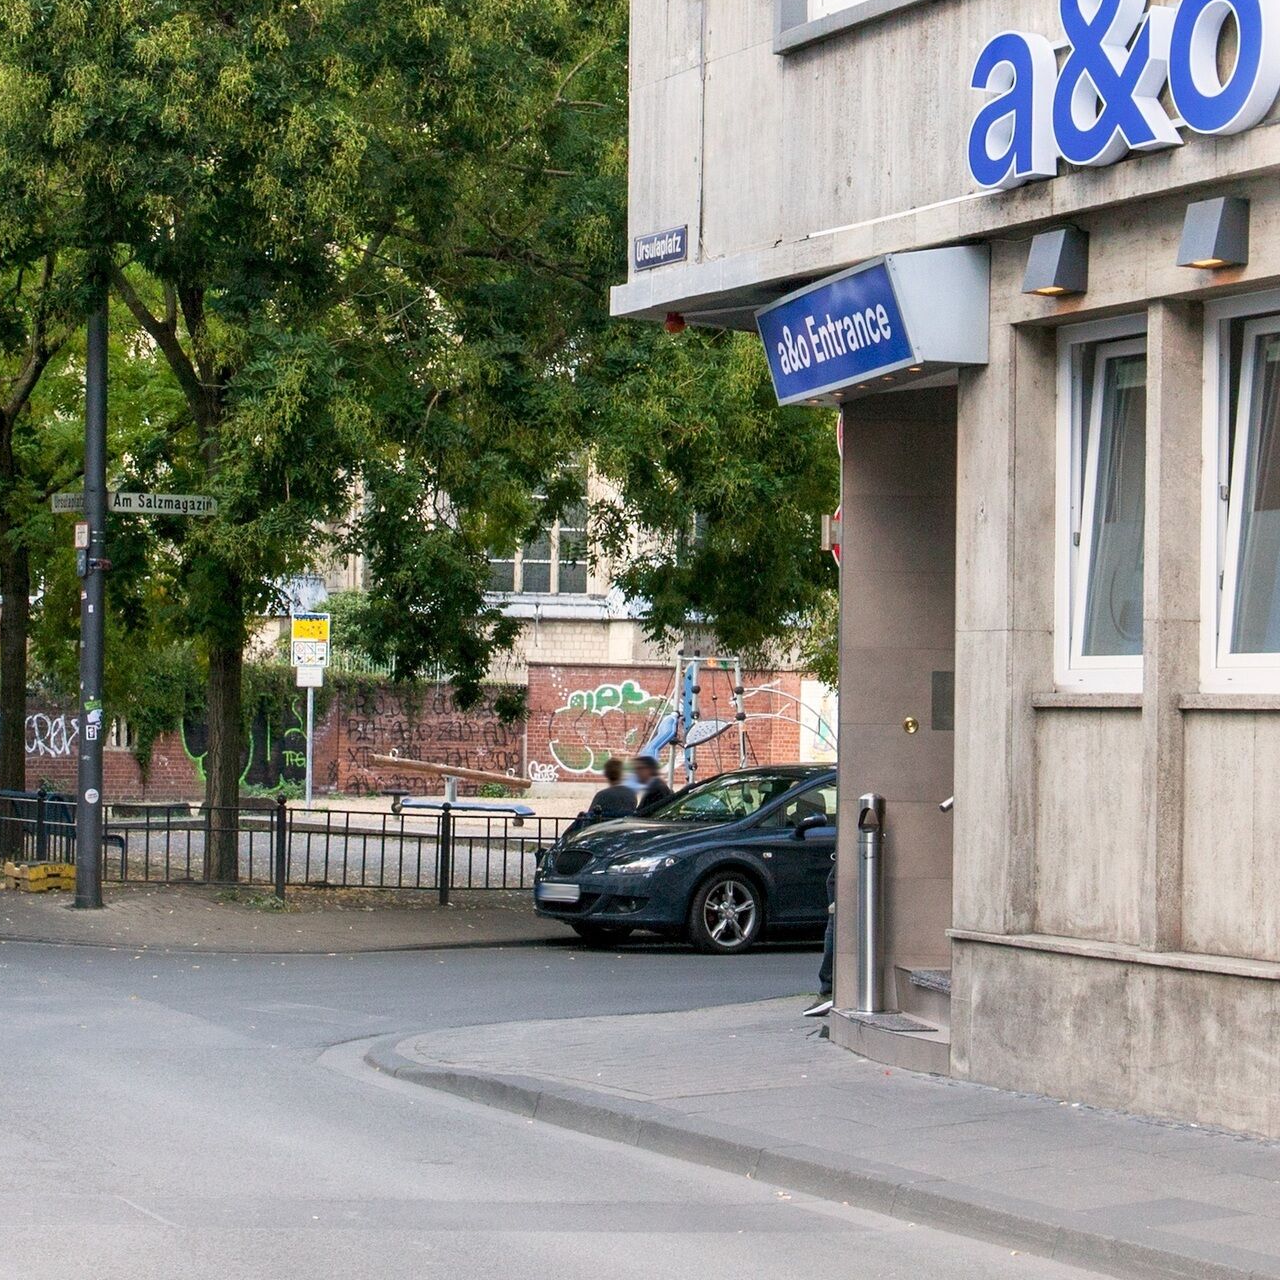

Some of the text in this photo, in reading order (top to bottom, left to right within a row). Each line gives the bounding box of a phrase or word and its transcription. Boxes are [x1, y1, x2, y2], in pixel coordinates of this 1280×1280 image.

[637, 233, 682, 262] Ursulaplatz
[778, 304, 891, 375] a&o Entrance
[114, 494, 213, 513] Am Salzmagazin
